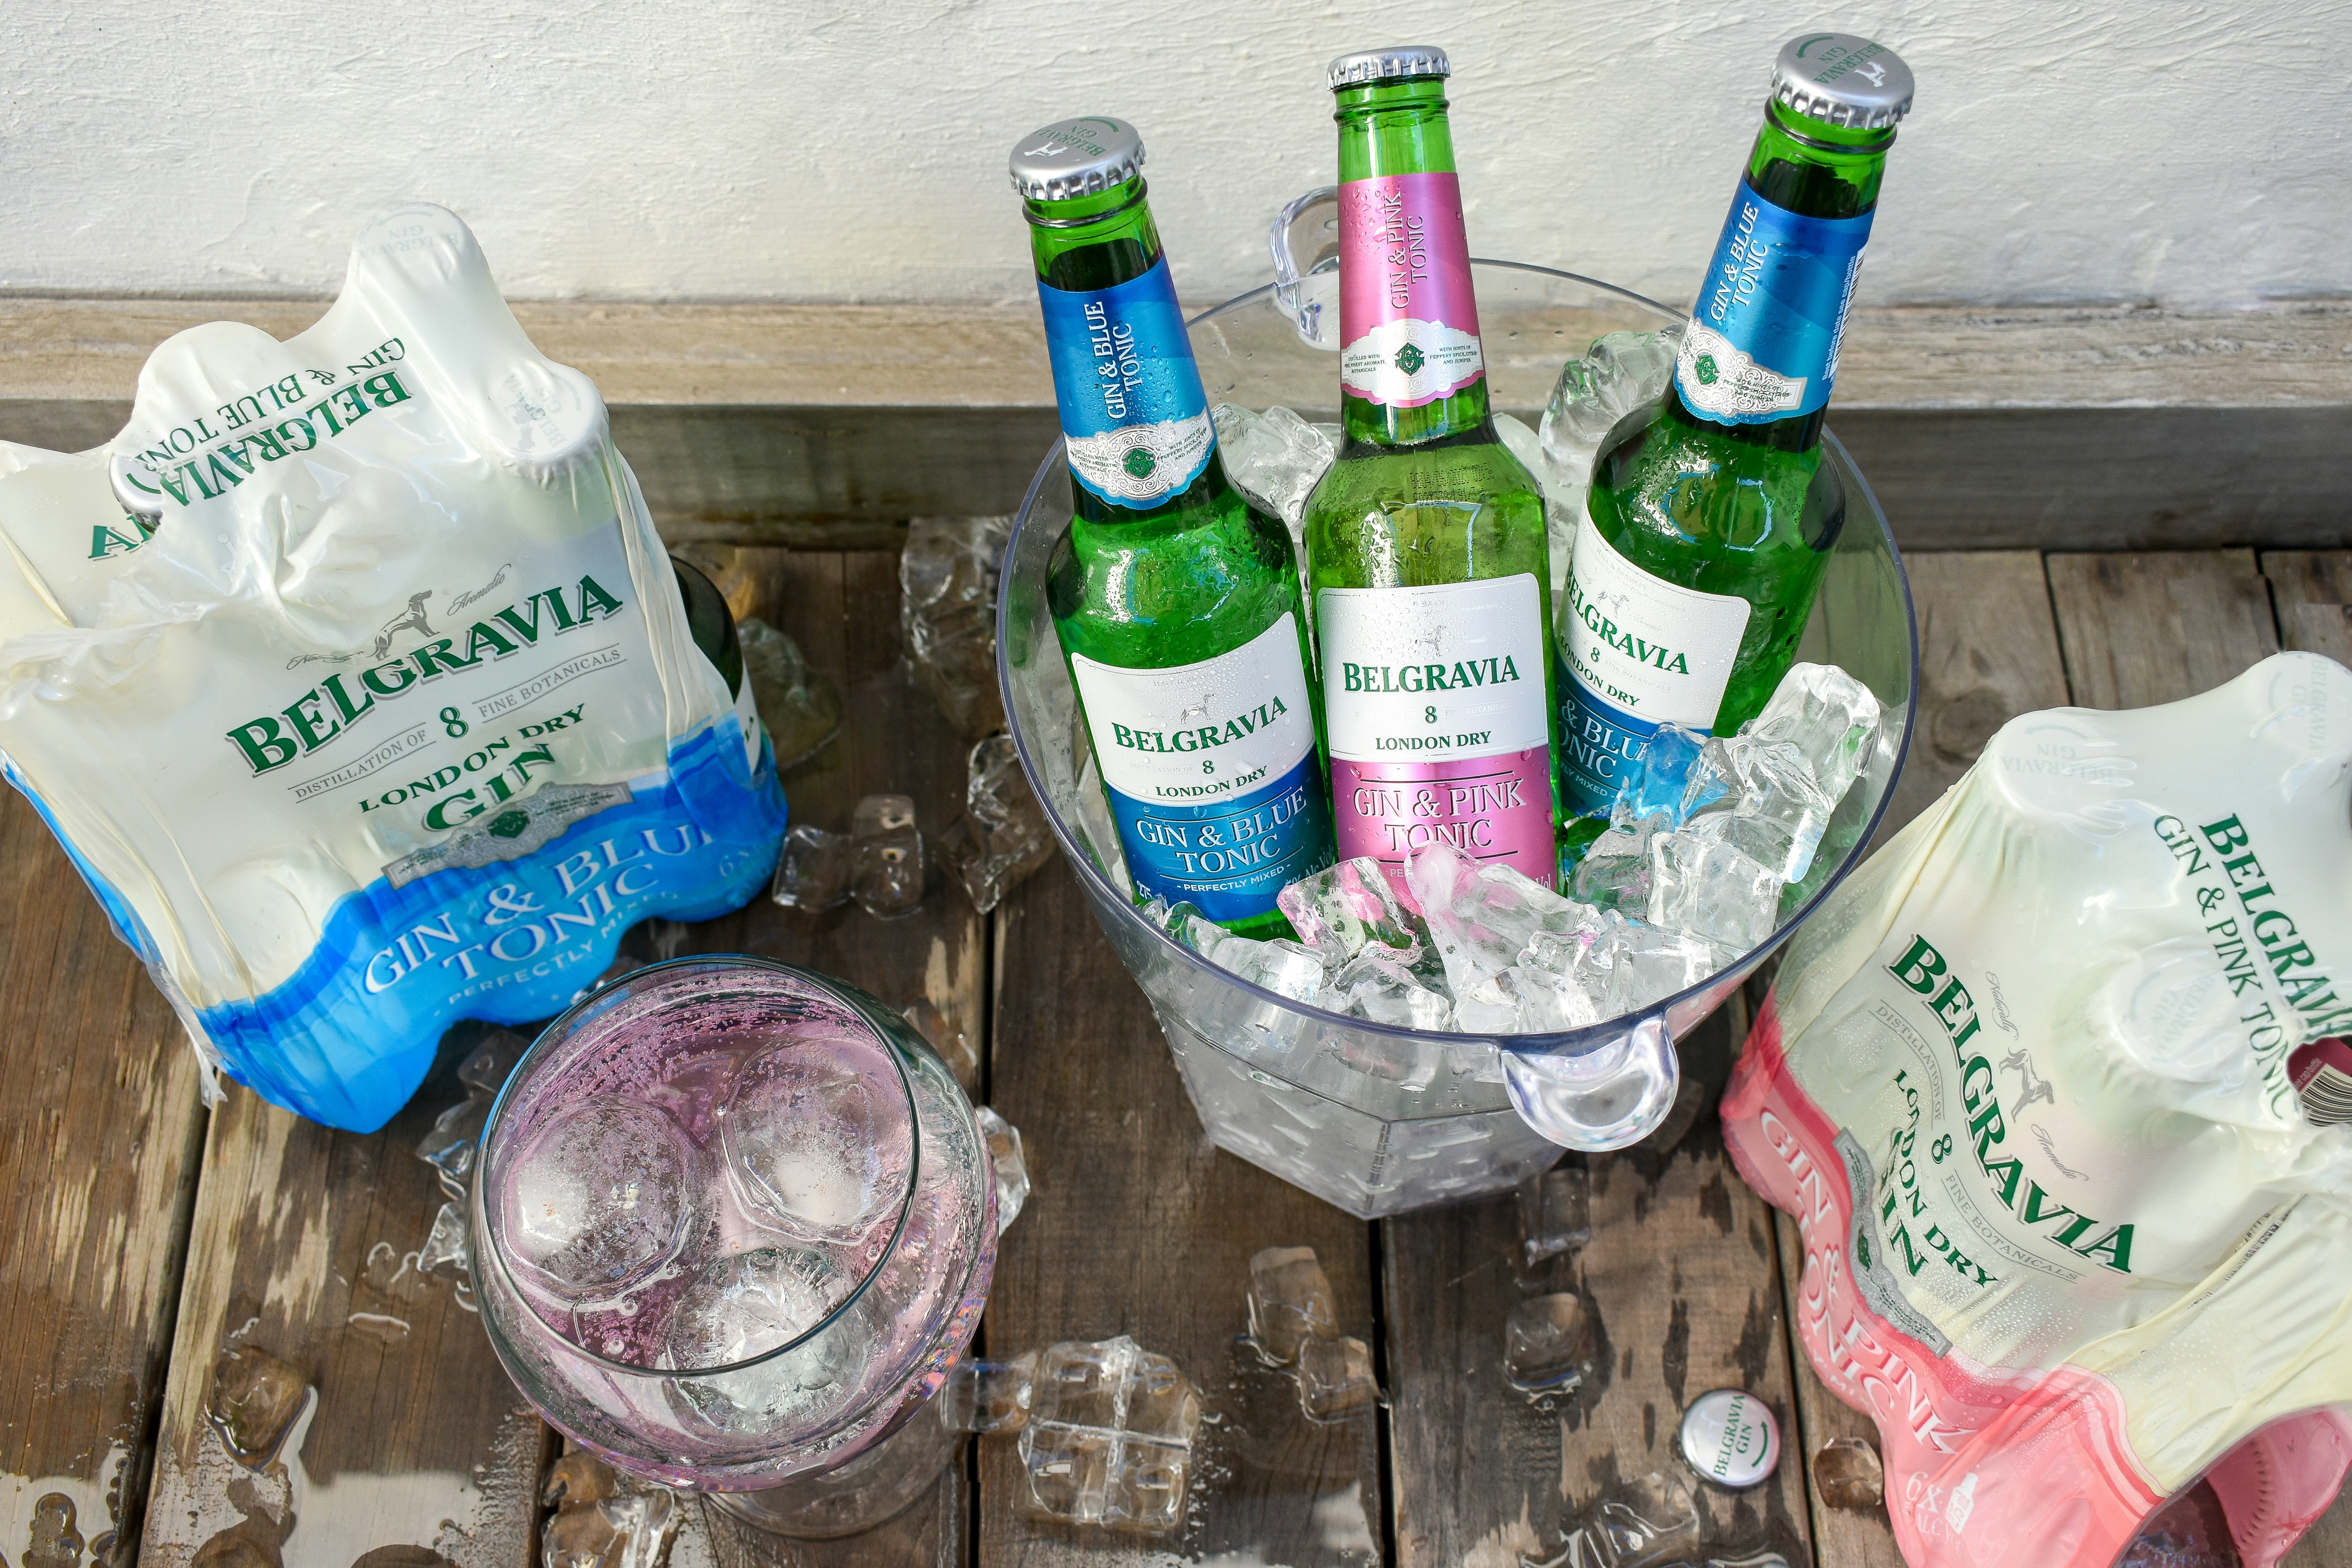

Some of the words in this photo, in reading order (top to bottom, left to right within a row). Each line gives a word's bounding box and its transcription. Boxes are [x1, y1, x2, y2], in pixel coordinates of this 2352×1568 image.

[1816, 47, 1847, 63] GIN
[1070, 125, 1098, 138] GIN
[1384, 191, 1404, 244] PINK
[1730, 201, 1758, 263] BLUE
[1388, 248, 1406, 265] &
[1406, 216, 1427, 284] TONIC
[1390, 272, 1410, 309] GIN
[1724, 263, 1739, 282] &
[1730, 239, 1768, 307] TONIC
[1709, 280, 1732, 321] GIN
[1084, 301, 1113, 358] BLUE
[305, 368, 336, 386] &
[347, 337, 406, 376] GIN
[1098, 360, 1117, 377] &
[1113, 323, 1143, 392] TONIC
[218, 373, 308, 431] BLUE
[1102, 383, 1126, 419] GIN
[160, 370, 413, 507] BELGRAVIA
[1160, 447, 1182, 460] PEPPERY
[1169, 441, 1182, 450] WITH
[1343, 654, 1520, 693] BELGRAVIA
[1560, 635, 1604, 688] LONDON
[1606, 684, 1640, 706] DRY
[1591, 647, 1600, 663] 8
[224, 575, 623, 778] BELGRAVIA
[296, 738, 404, 798] DISTILLATION
[407, 730, 427, 748] OF
[439, 705, 469, 739] 8
[478, 692, 517, 718] FINE
[521, 649, 621, 701] BOTANICALS
[1112, 696, 1288, 753] BELGRAVIA
[1425, 706, 1438, 724] 8
[1562, 700, 1578, 728] &
[358, 736, 510, 813] LONDON
[518, 703, 585, 739] DRY
[1376, 736, 1451, 750] LONDON
[1457, 731, 1491, 747] DRY
[1558, 721, 1617, 778] ONIC
[2037, 744, 2077, 759] GIN
[422, 743, 556, 832] GIN
[1156, 780, 1230, 797] LONDON
[1236, 765, 1268, 787] DRY
[1202, 760, 1215, 774] 8
[1575, 775, 1608, 797] MIXED
[1135, 819, 1188, 848] GIN
[1196, 824, 1227, 848] &
[1232, 787, 1308, 842] BLUE
[1353, 787, 1402, 818] GIN
[1413, 786, 1443, 818] &
[1449, 778, 1526, 817] PINK
[1175, 833, 1281, 874] TONIC
[2153, 814, 2211, 876] GIN
[1184, 880, 1247, 892] PERFECTLY
[1251, 866, 1284, 884] MIXED
[440, 863, 659, 981] TONIC
[2196, 887, 2225, 917] &
[363, 911, 461, 994] GIN
[481, 882, 545, 926] &
[2206, 916, 2262, 998] PINK
[449, 939, 592, 1004] PERFECTLY
[1985, 971, 2019, 1040] Naturally
[1876, 1006, 1940, 1097] DISTILLATION
[1885, 934, 2134, 1273] BELGRAVIA
[1934, 1100, 1941, 1120] OF
[1931, 1132, 1953, 1164] 8
[1946, 1175, 1971, 1214] FINE
[1924, 1223, 1999, 1288] DRY
[1971, 1216, 2077, 1280] BOTANICALS
[1760, 1107, 1832, 1224] GIN
[1840, 1311, 1978, 1453] PINK
[1713, 1396, 1745, 1476] BELGRAVIA
[1736, 1424, 1753, 1454] GIN
